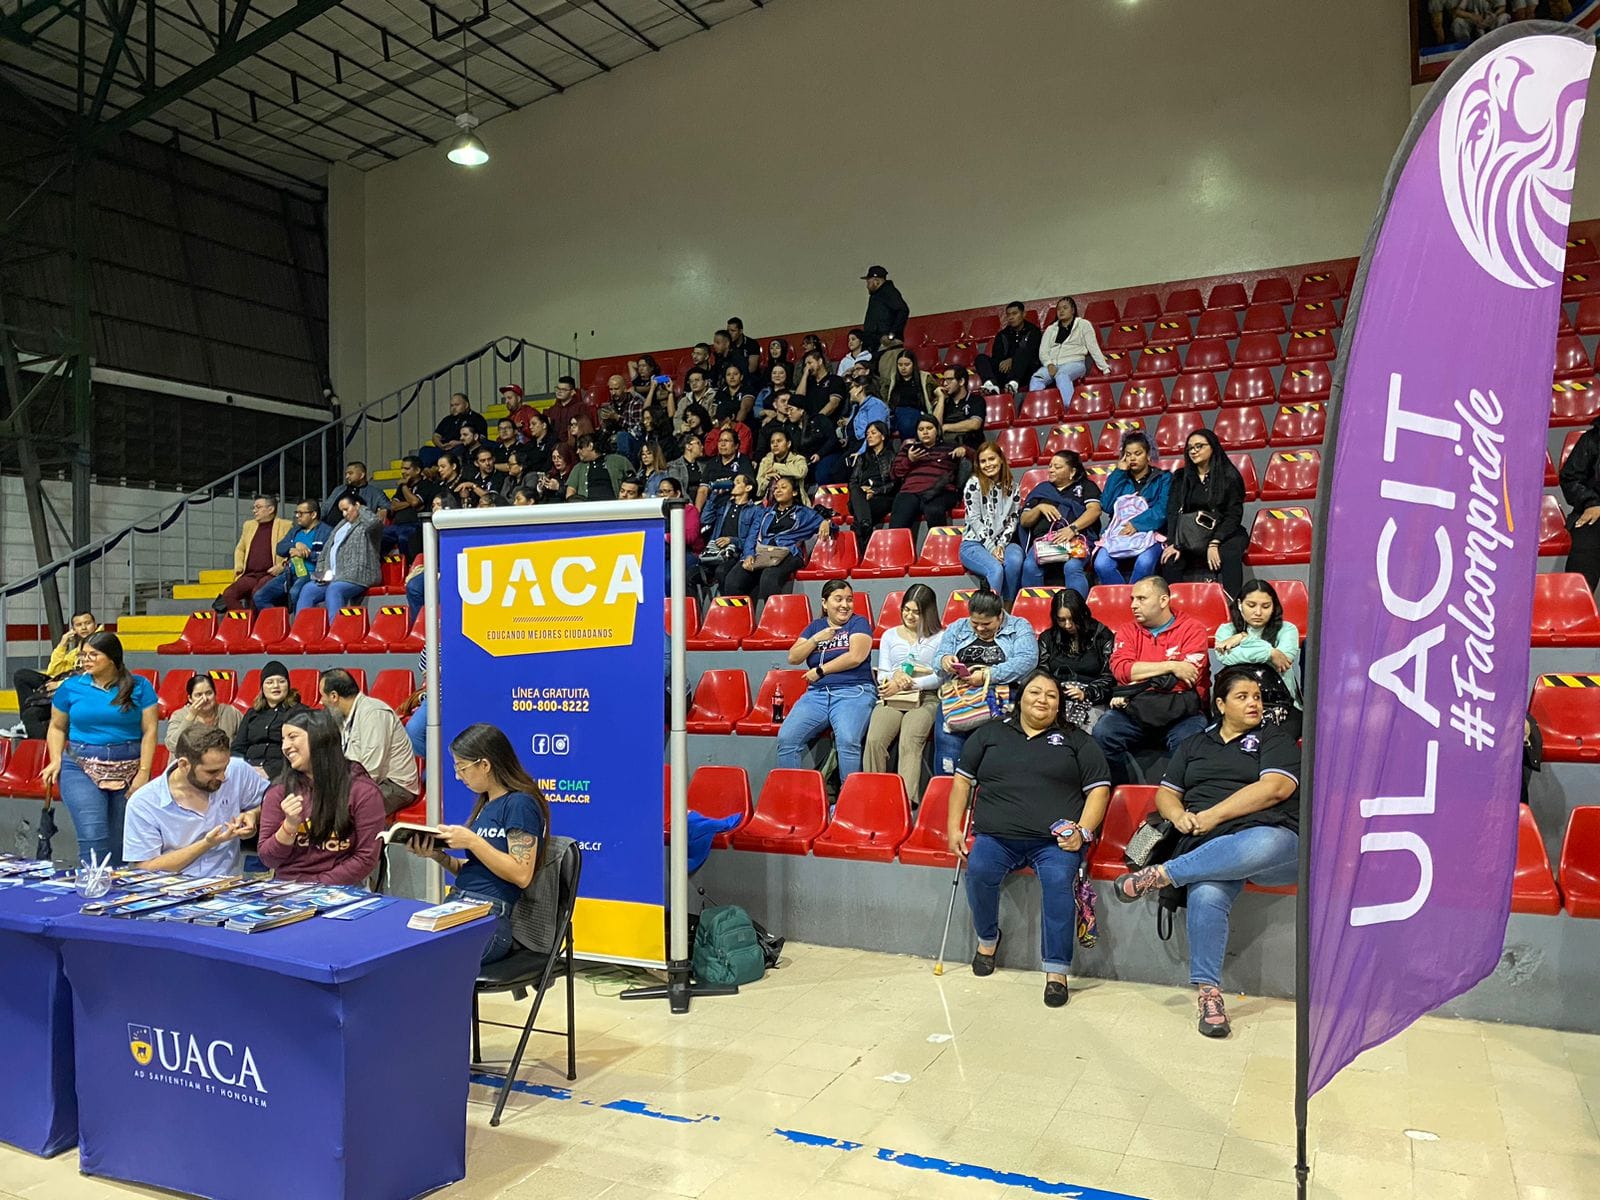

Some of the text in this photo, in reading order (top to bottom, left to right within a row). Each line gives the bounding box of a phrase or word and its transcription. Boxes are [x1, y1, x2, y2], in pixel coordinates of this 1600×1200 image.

[457, 553, 644, 607] UACA
[1447, 388, 1514, 752] #Falconpride
[487, 629, 613, 640] EDUCANDO MEJORES CIUDADANOS
[1350, 372, 1461, 927] ULACIT
[512, 686, 590, 699] LÍNEA GRATUITA
[512, 700, 590, 712] 800-800-8222
[537, 778, 591, 791] INE CHAT
[544, 793, 591, 804] ACA.AC.CR
[153, 1027, 268, 1094] UACA
[134, 1070, 267, 1108] AD SAPIENTIAM ET HONOREM
